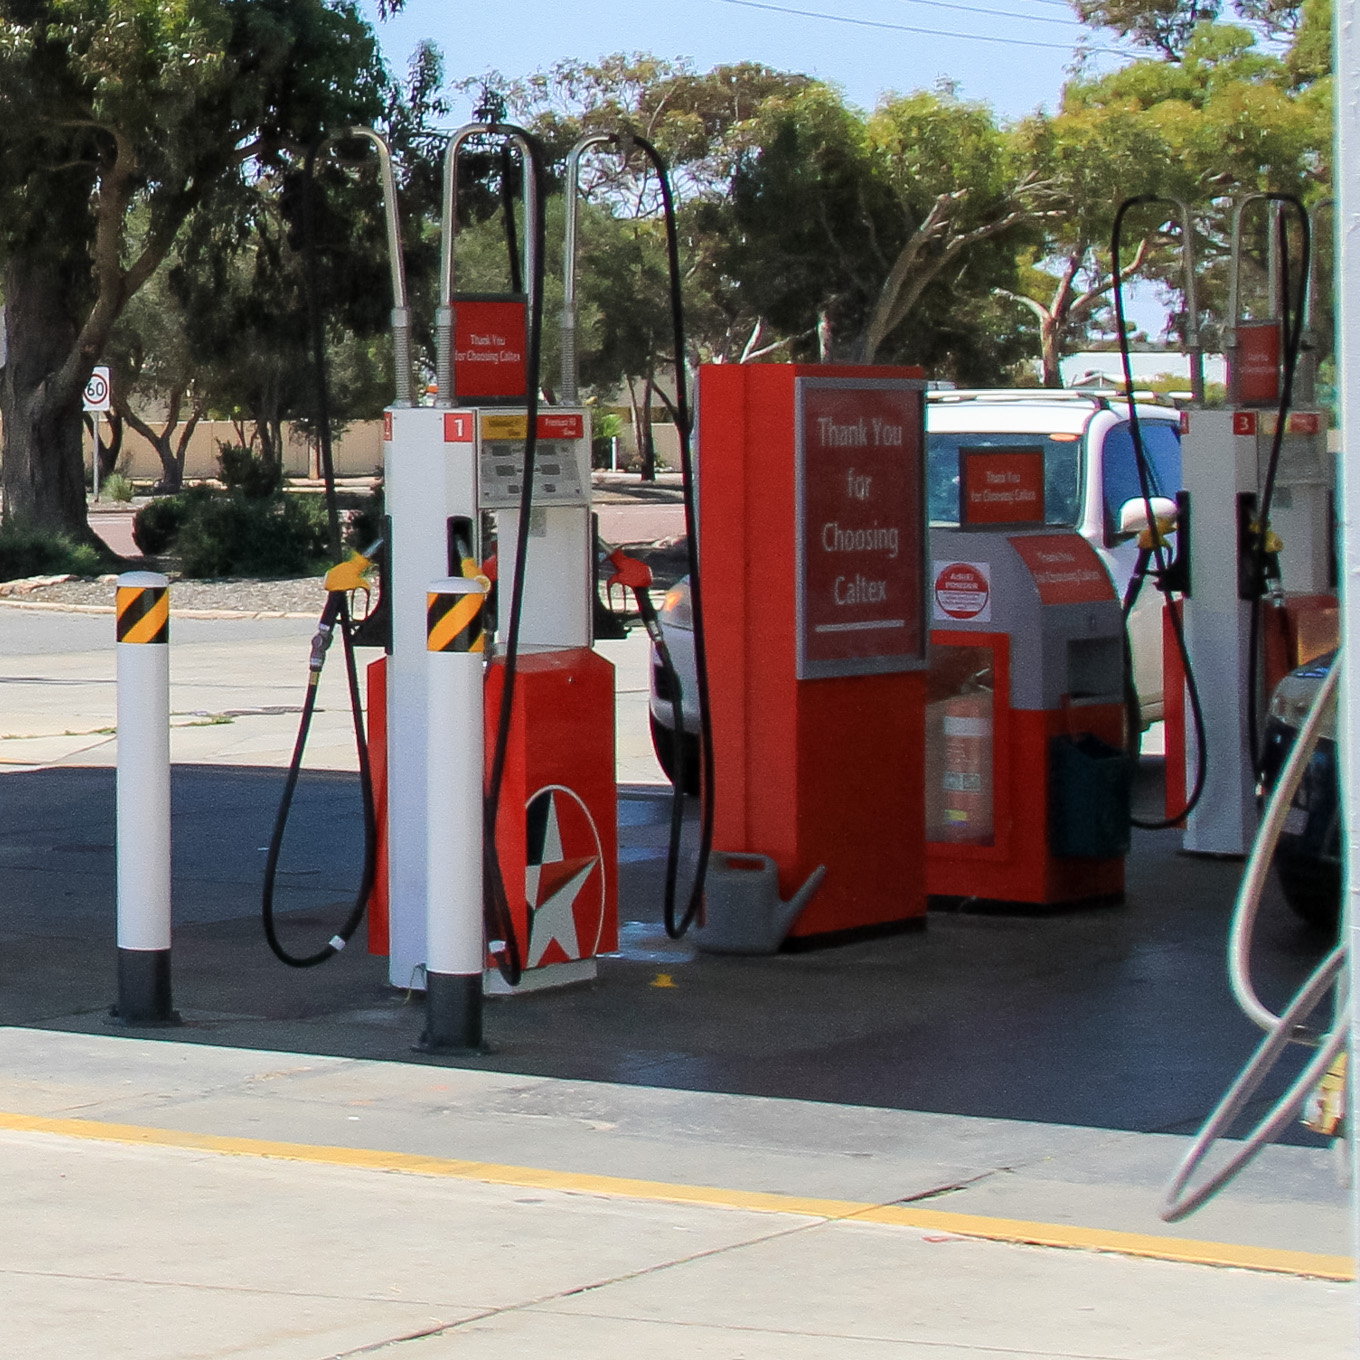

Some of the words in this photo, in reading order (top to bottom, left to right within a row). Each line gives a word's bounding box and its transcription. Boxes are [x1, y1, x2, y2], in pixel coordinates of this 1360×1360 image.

[87, 381, 105, 397] 60
[454, 418, 464, 437] 1
[817, 415, 868, 447] Thank
[871, 415, 903, 447] You
[1239, 415, 1250, 431] 3
[821, 519, 900, 559] Choosing
[833, 573, 887, 606] Caltex
